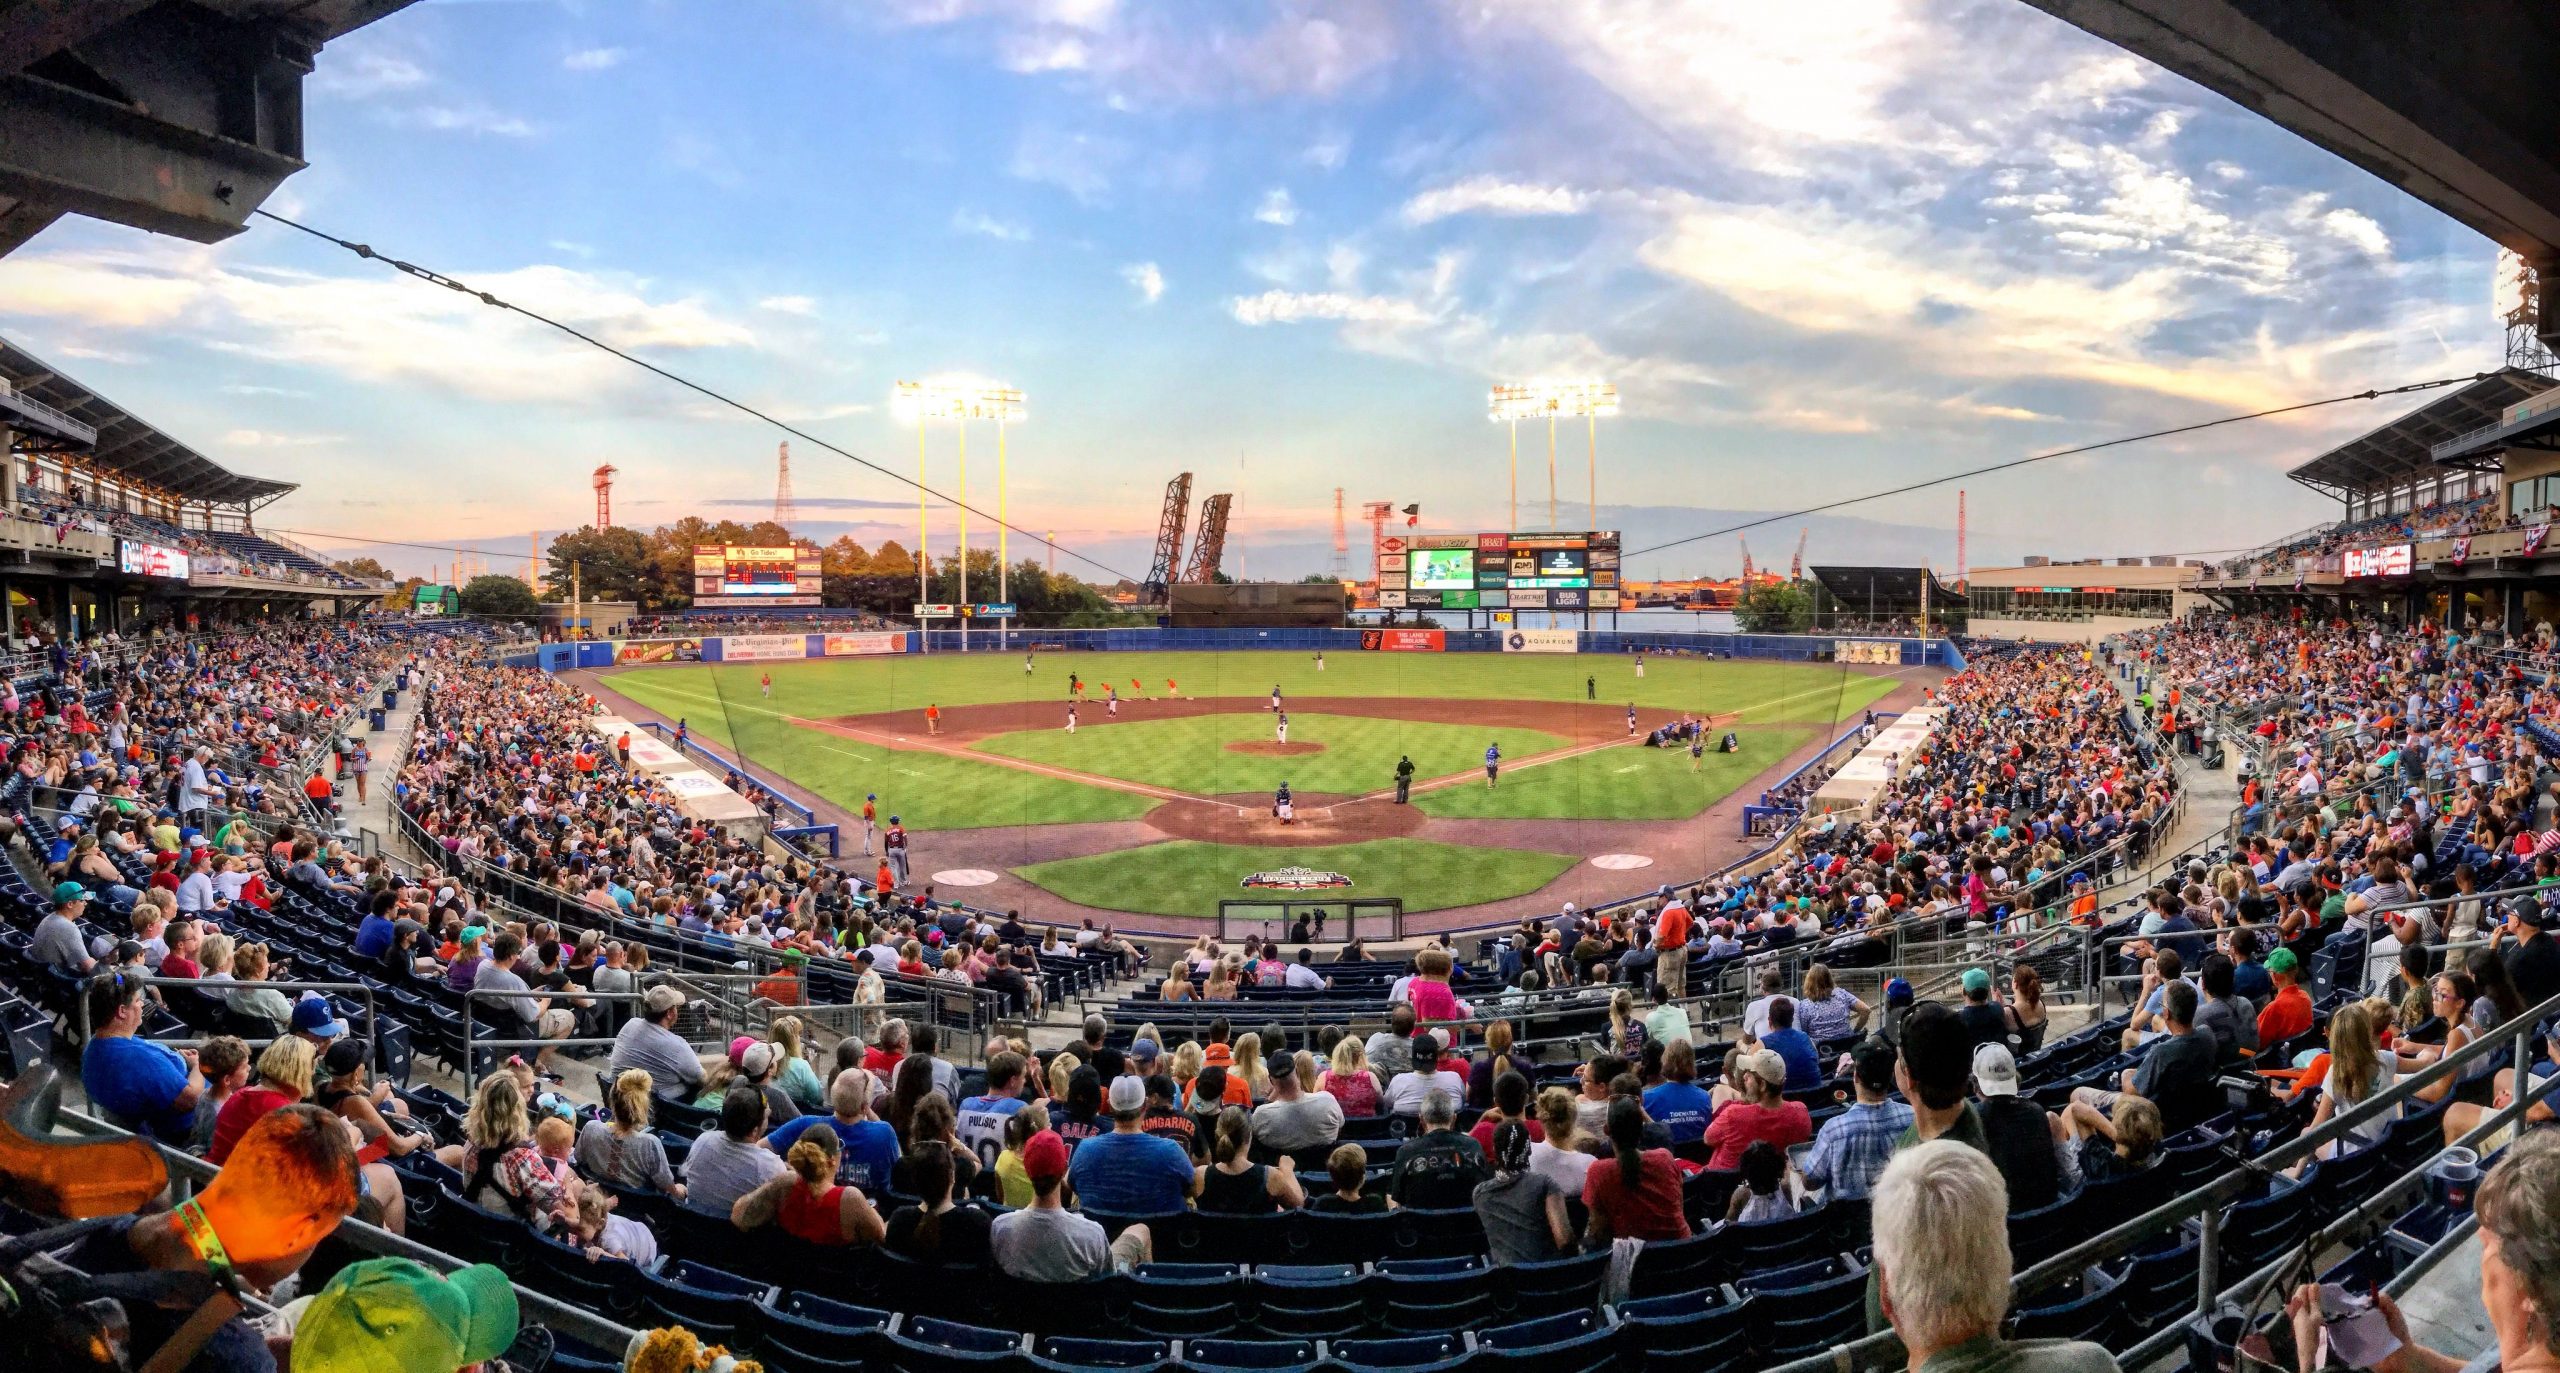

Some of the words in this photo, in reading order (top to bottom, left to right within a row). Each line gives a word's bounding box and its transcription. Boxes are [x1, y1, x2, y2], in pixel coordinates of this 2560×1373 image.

[1481, 538, 1505, 547] BB&T
[962, 608, 972, 616] 75
[991, 606, 1012, 614] pepsi
[745, 637, 798, 646] Virginian-Pilot
[624, 648, 642, 659] XX
[891, 833, 900, 842] 16
[968, 1115, 997, 1130] PULISIC
[1141, 1116, 1196, 1137] UMGARNER
